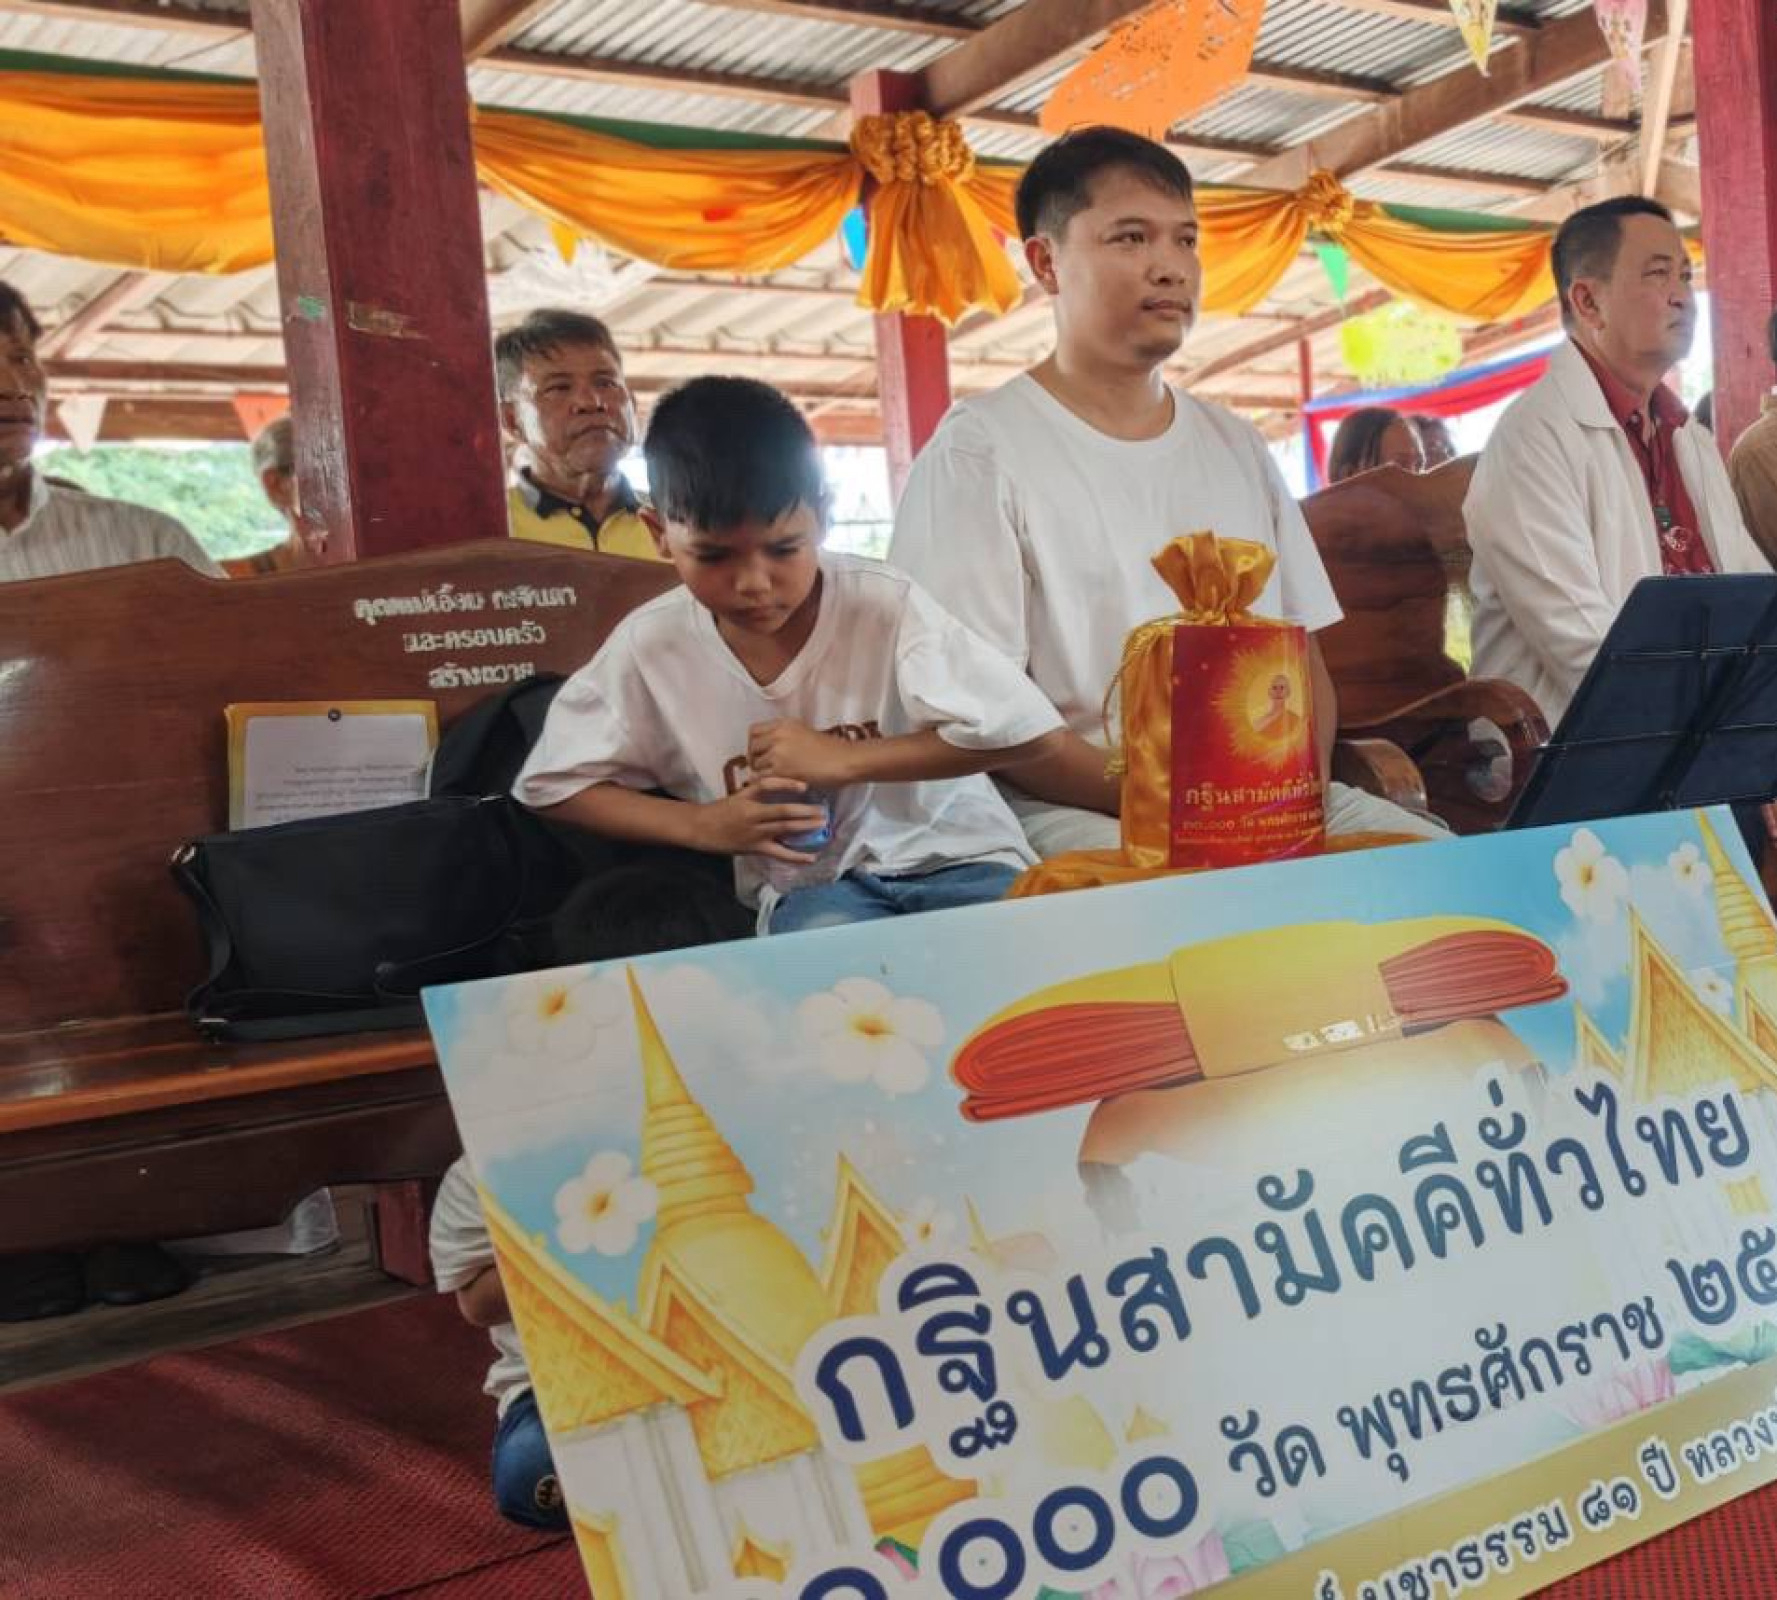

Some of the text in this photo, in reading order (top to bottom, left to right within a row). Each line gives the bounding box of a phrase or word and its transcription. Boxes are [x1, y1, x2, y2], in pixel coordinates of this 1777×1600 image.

[402, 619, 547, 653] และครอบครัว
[814, 1076, 1751, 1459] กฐินสามัคคีทั่วไทย
[1218, 1408, 1326, 1498] วัด
[1336, 1295, 1665, 1483] พุทธศักราช
[1361, 1506, 1571, 1600] บชาธรรม
[1582, 1481, 1639, 1527] ๘๑
[1641, 1441, 1676, 1495] ปี
